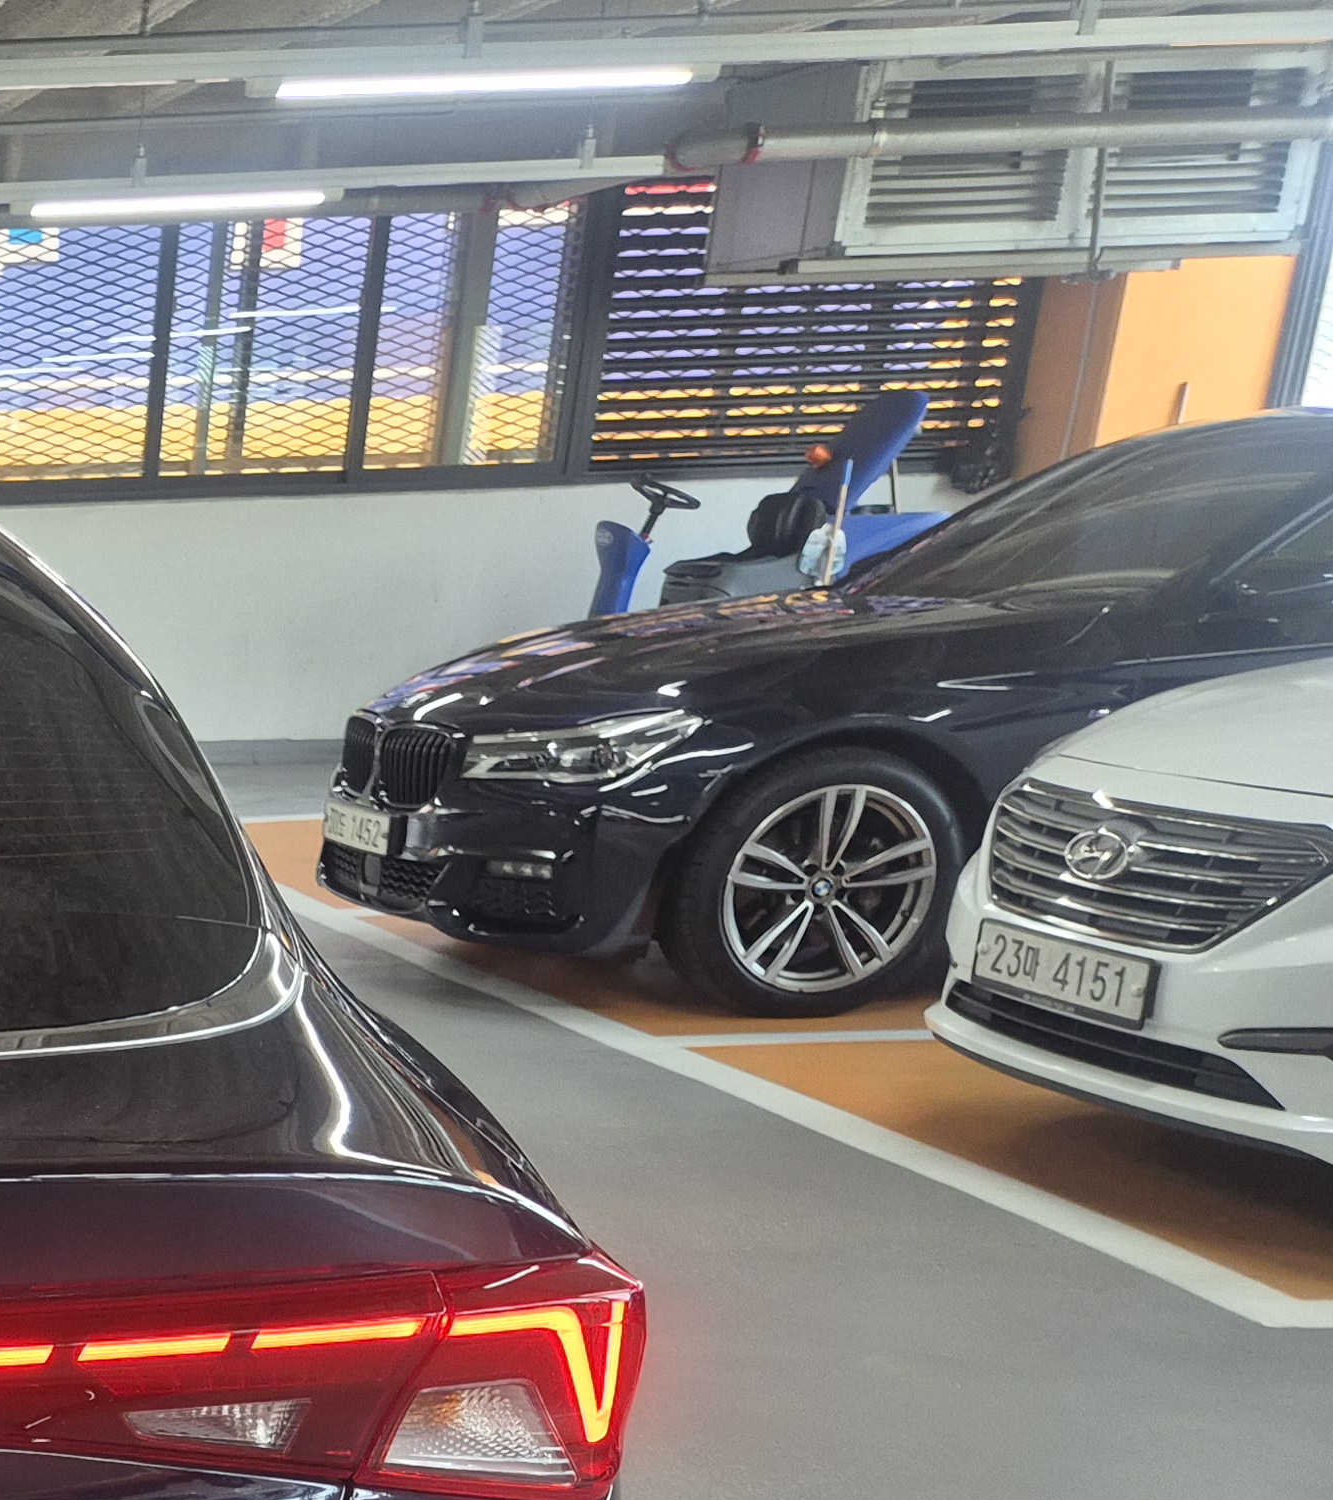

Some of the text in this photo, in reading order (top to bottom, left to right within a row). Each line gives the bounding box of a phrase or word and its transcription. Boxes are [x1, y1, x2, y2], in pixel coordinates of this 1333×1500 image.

[350, 815, 381, 849] 1452
[990, 933, 1128, 1008] 23마 4151
